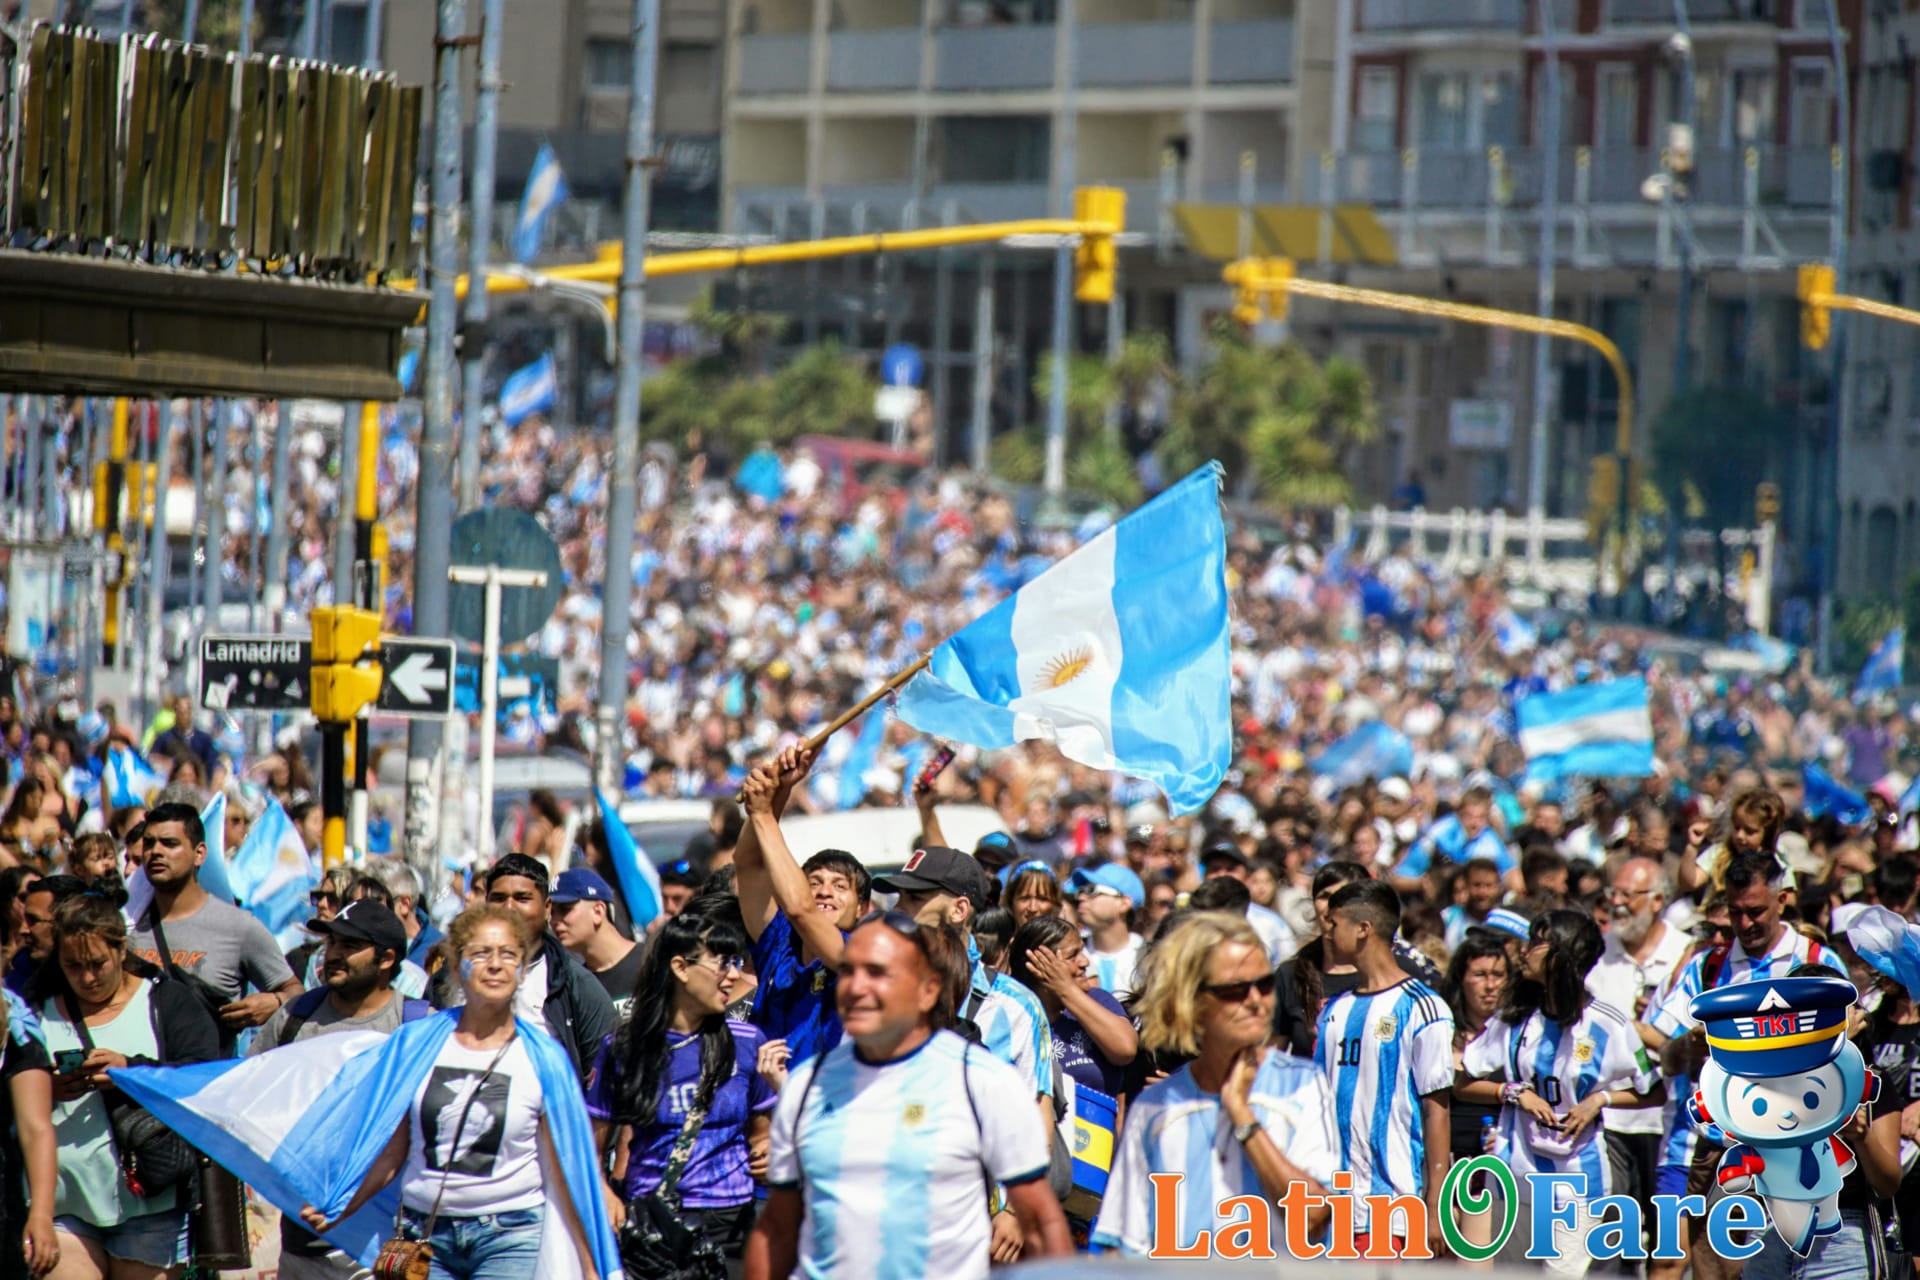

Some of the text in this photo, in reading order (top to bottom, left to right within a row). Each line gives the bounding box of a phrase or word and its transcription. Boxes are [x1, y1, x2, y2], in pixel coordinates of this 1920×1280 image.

[205, 640, 300, 663] Lamadrid
[1337, 1037, 1361, 1066] 10
[667, 1083, 699, 1113] 10
